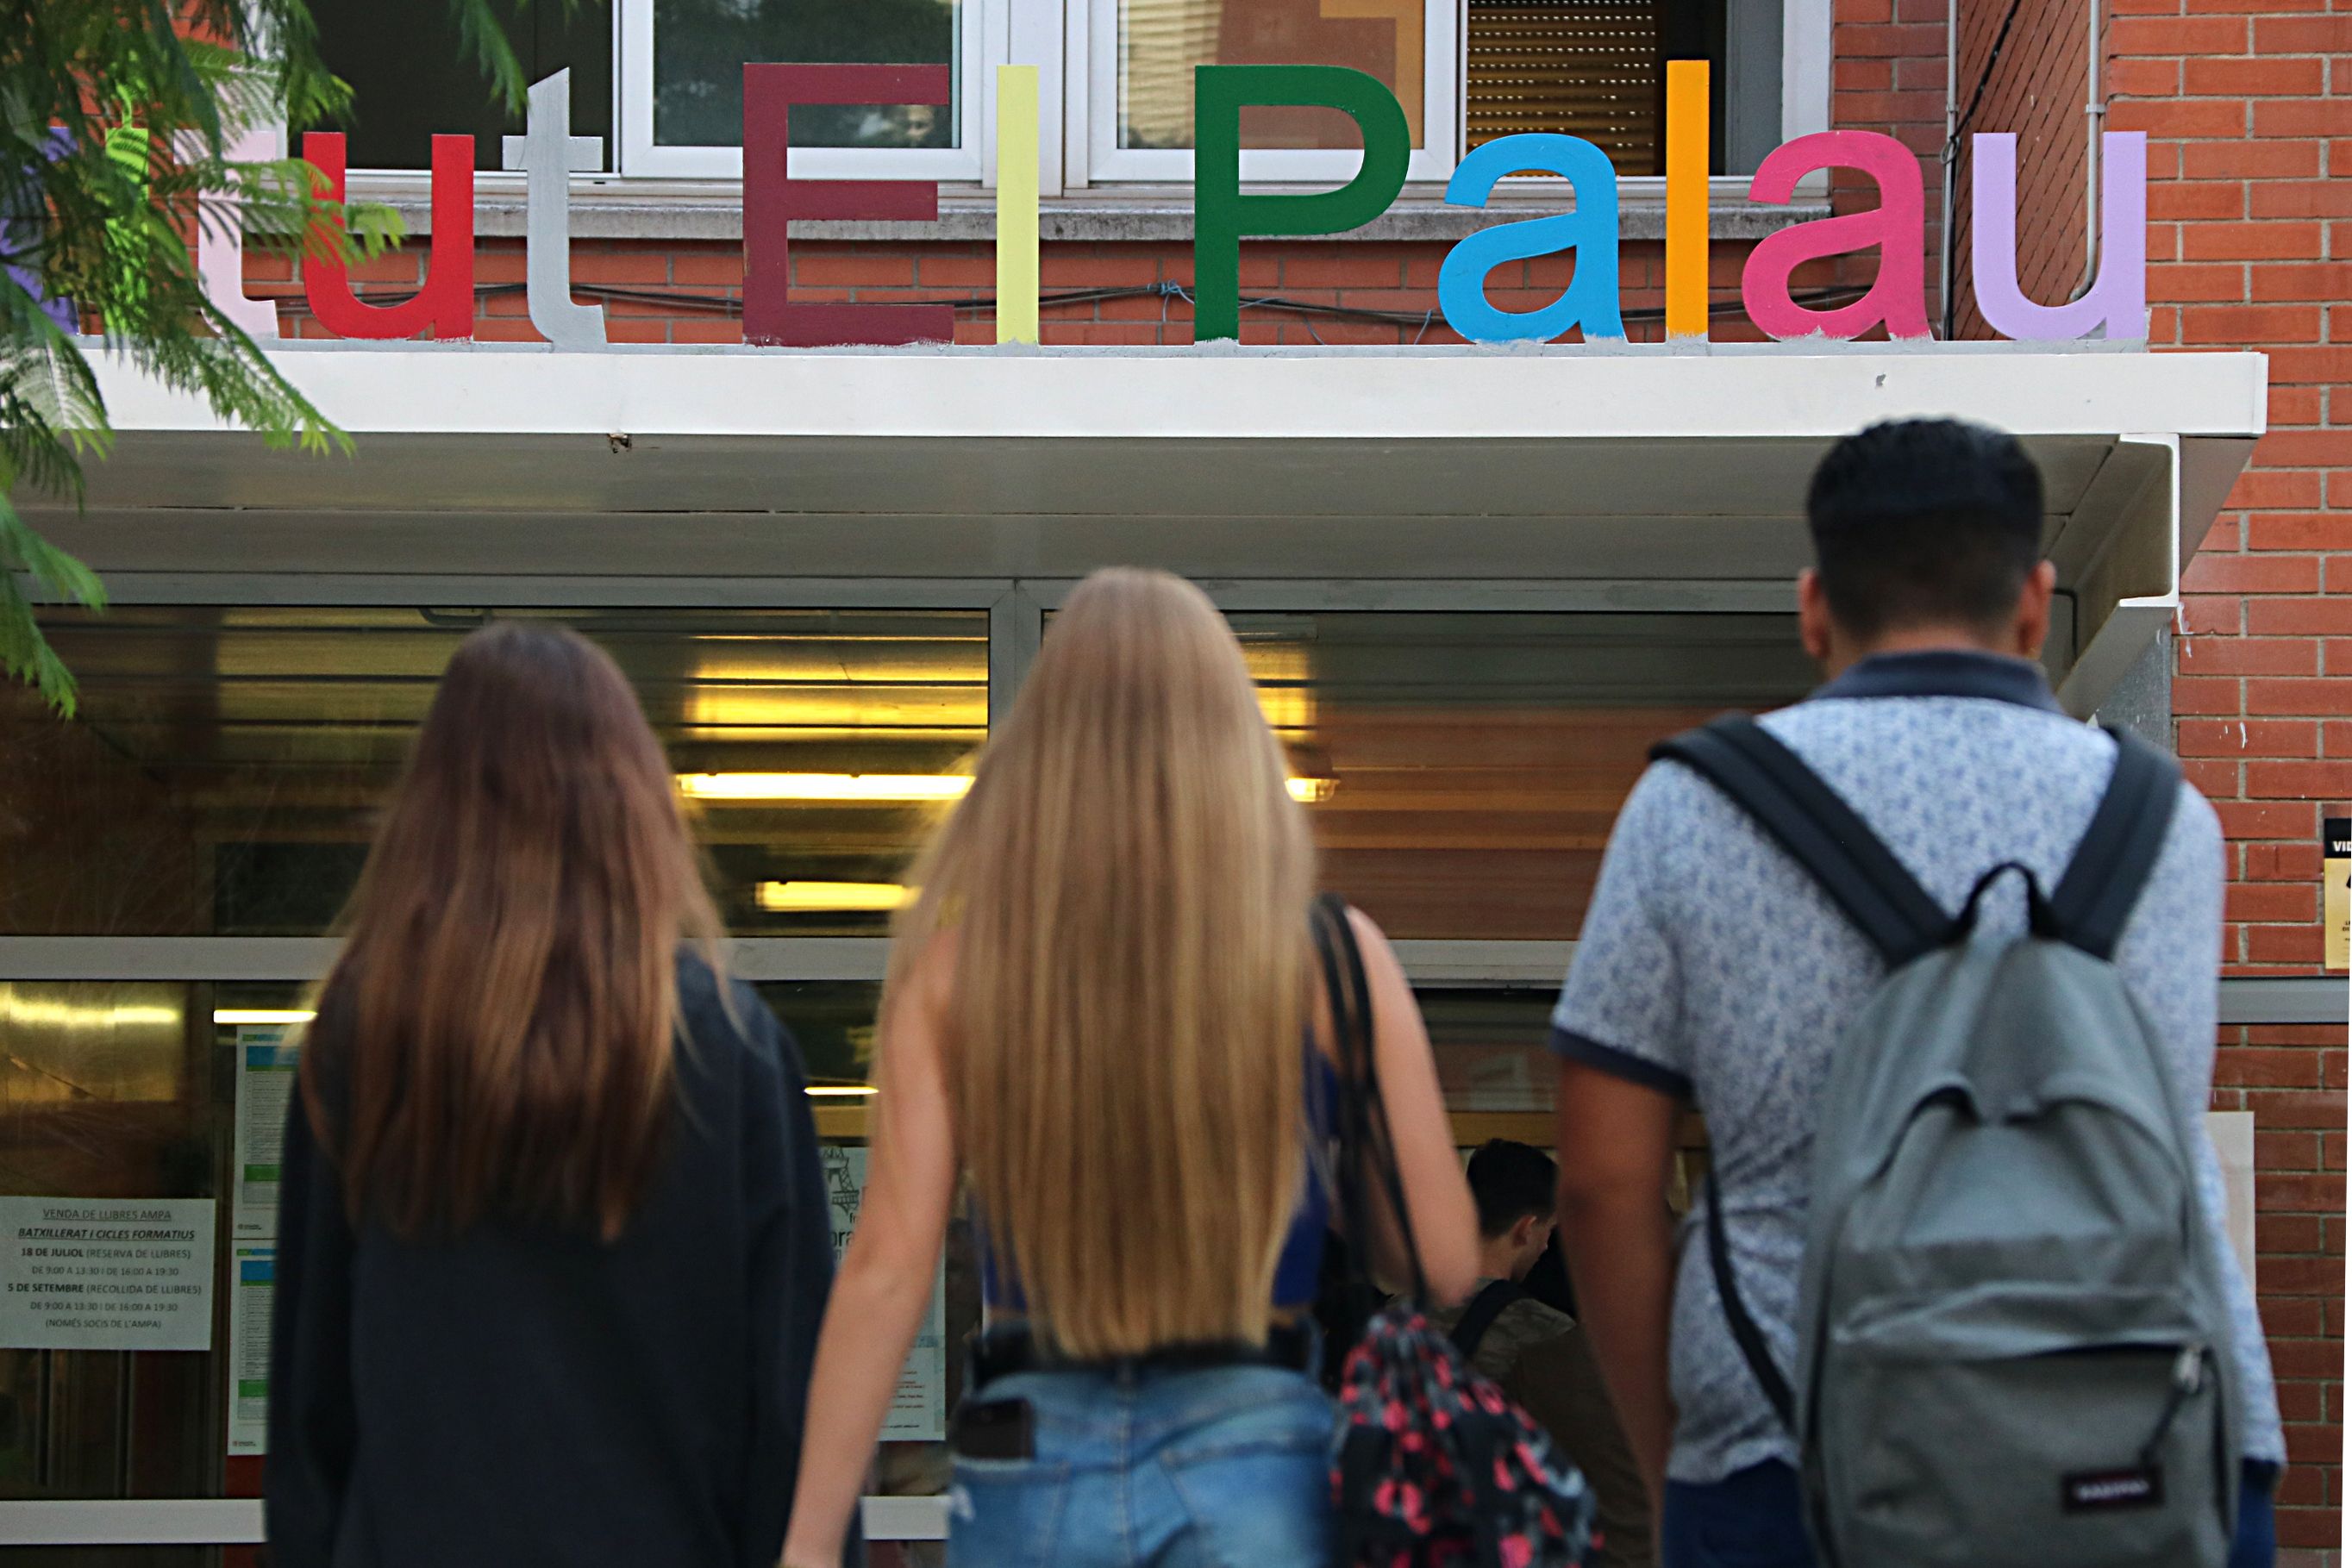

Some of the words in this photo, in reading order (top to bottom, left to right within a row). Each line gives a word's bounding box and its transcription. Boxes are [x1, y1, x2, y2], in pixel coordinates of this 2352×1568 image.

[743, 63, 1041, 347] El
[1195, 59, 2149, 347] Palau
[43, 1209, 79, 1219] VENDA
[83, 1209, 96, 1219] DE
[99, 1209, 137, 1220] LLIBRES
[141, 1209, 171, 1220] AMPA
[18, 1228, 87, 1239] BATXILLERAT
[96, 1229, 129, 1240] CICLES
[132, 1229, 195, 1240] FORMATIUS
[21, 1248, 33, 1257] 18
[35, 1248, 47, 1257] DE
[51, 1248, 84, 1258] JULIOL
[87, 1249, 133, 1259] (RESERVA
[135, 1249, 147, 1259] DE
[151, 1250, 191, 1259] LLIBRES)
[16, 1283, 29, 1292] DE
[33, 1283, 84, 1292] SETEMBRE
[87, 1284, 143, 1294] (RECOLLIDA
[146, 1284, 158, 1294] DE
[161, 1284, 202, 1295] LLIBRES)
[66, 1302, 72, 1310] A
[104, 1303, 116, 1311] DE
[45, 1319, 81, 1328] (NOMÉS
[84, 1320, 108, 1328] SOCIS
[110, 1320, 123, 1328] DE
